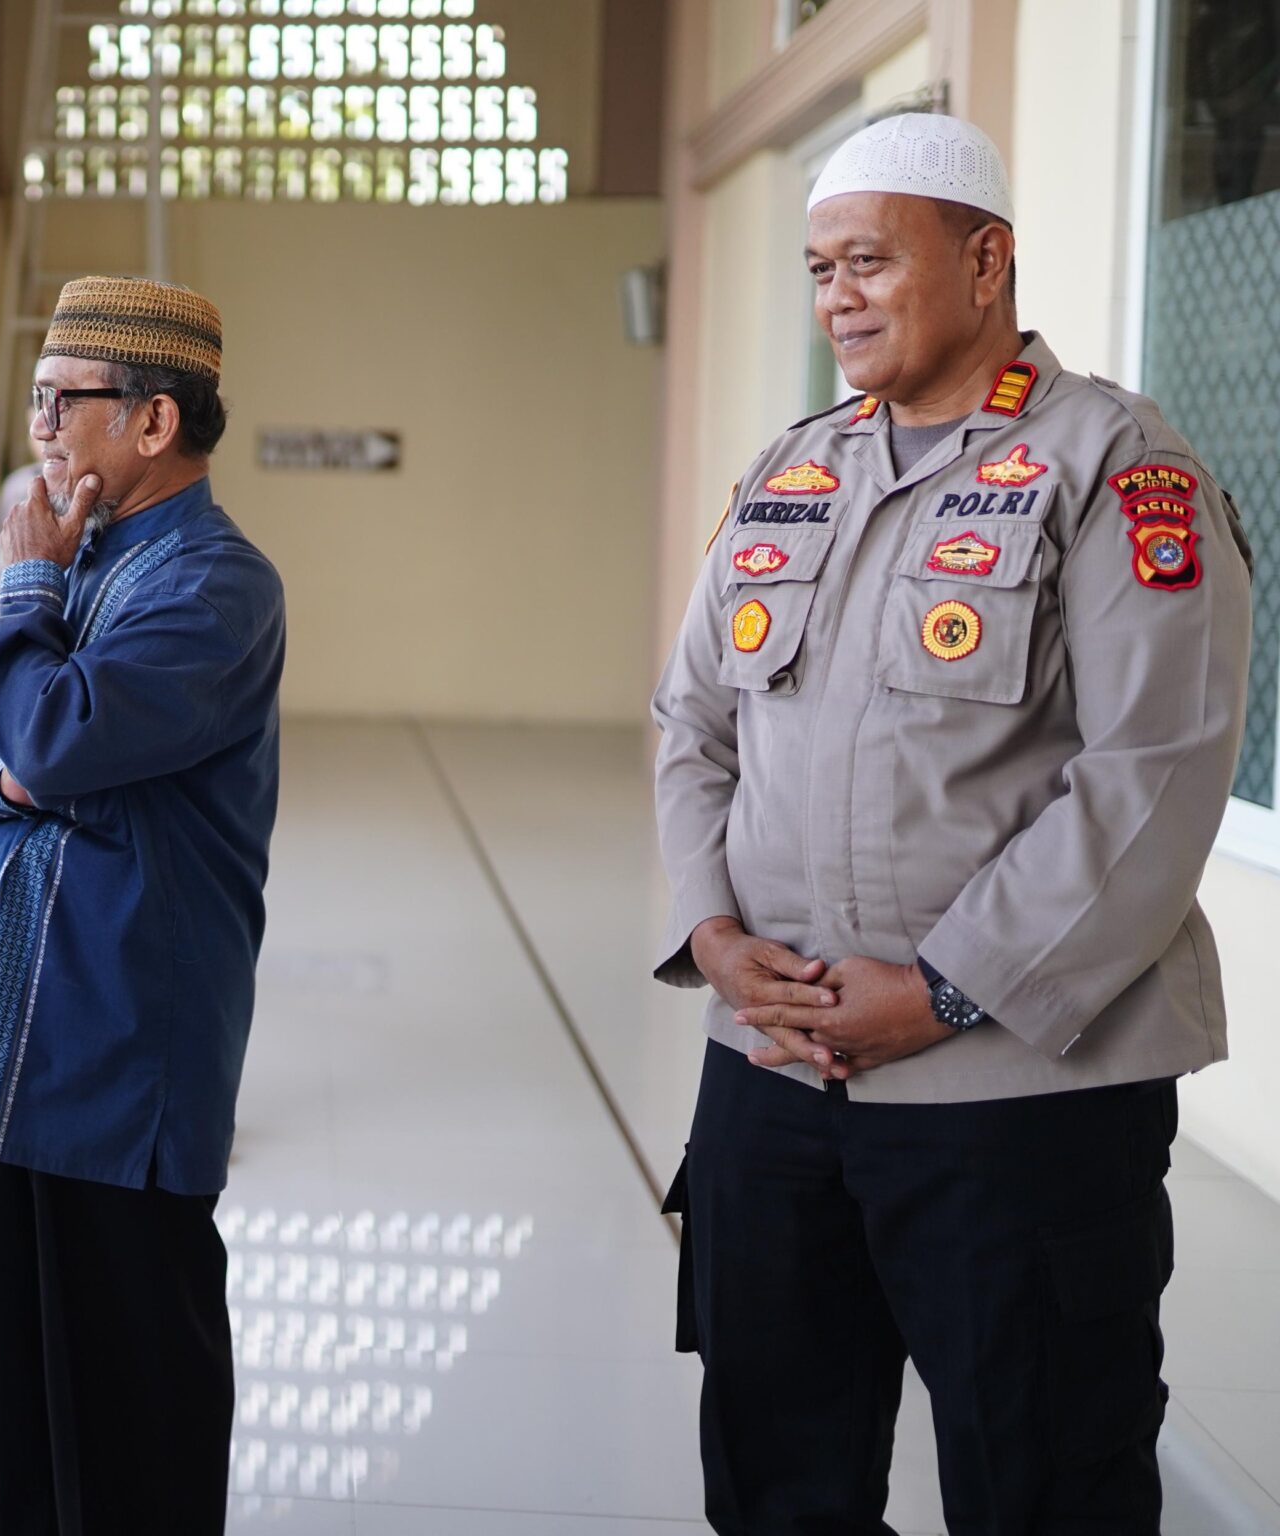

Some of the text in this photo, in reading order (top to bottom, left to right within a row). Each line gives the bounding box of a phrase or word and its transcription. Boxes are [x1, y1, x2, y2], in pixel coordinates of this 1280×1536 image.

[1117, 469, 1190, 489] POLRES
[1138, 480, 1173, 490] PIDIE
[935, 490, 1040, 517] POLRI
[1136, 501, 1185, 515] ACEH
[734, 502, 832, 528] UKRIZAL
